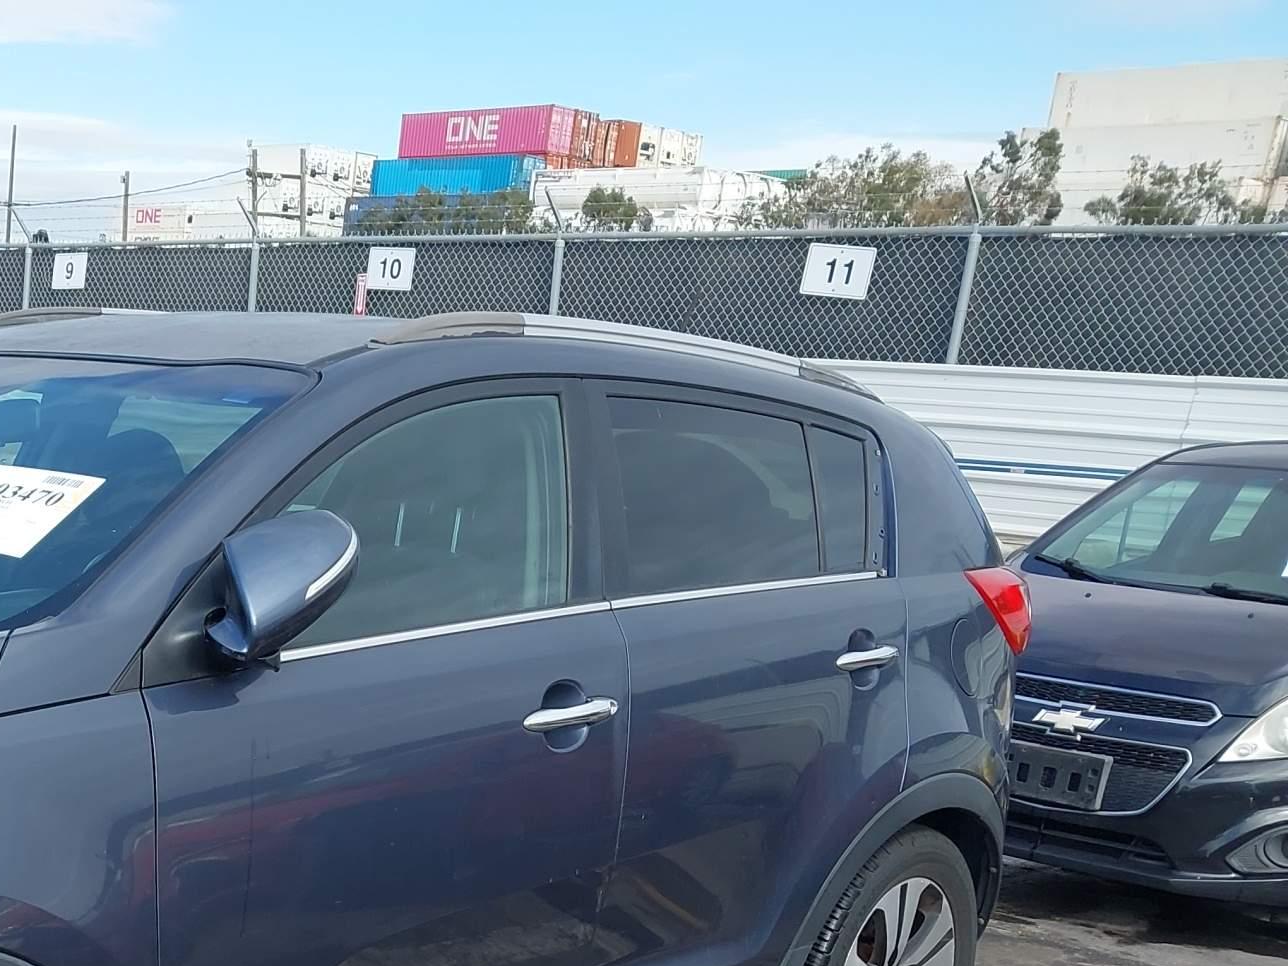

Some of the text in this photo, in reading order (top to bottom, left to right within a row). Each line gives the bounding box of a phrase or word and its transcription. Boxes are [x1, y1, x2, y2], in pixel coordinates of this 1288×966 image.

[445, 114, 500, 142] ONE
[136, 208, 162, 224] ONE
[65, 262, 74, 280] 9
[380, 257, 402, 280] 10
[826, 258, 855, 285] 11
